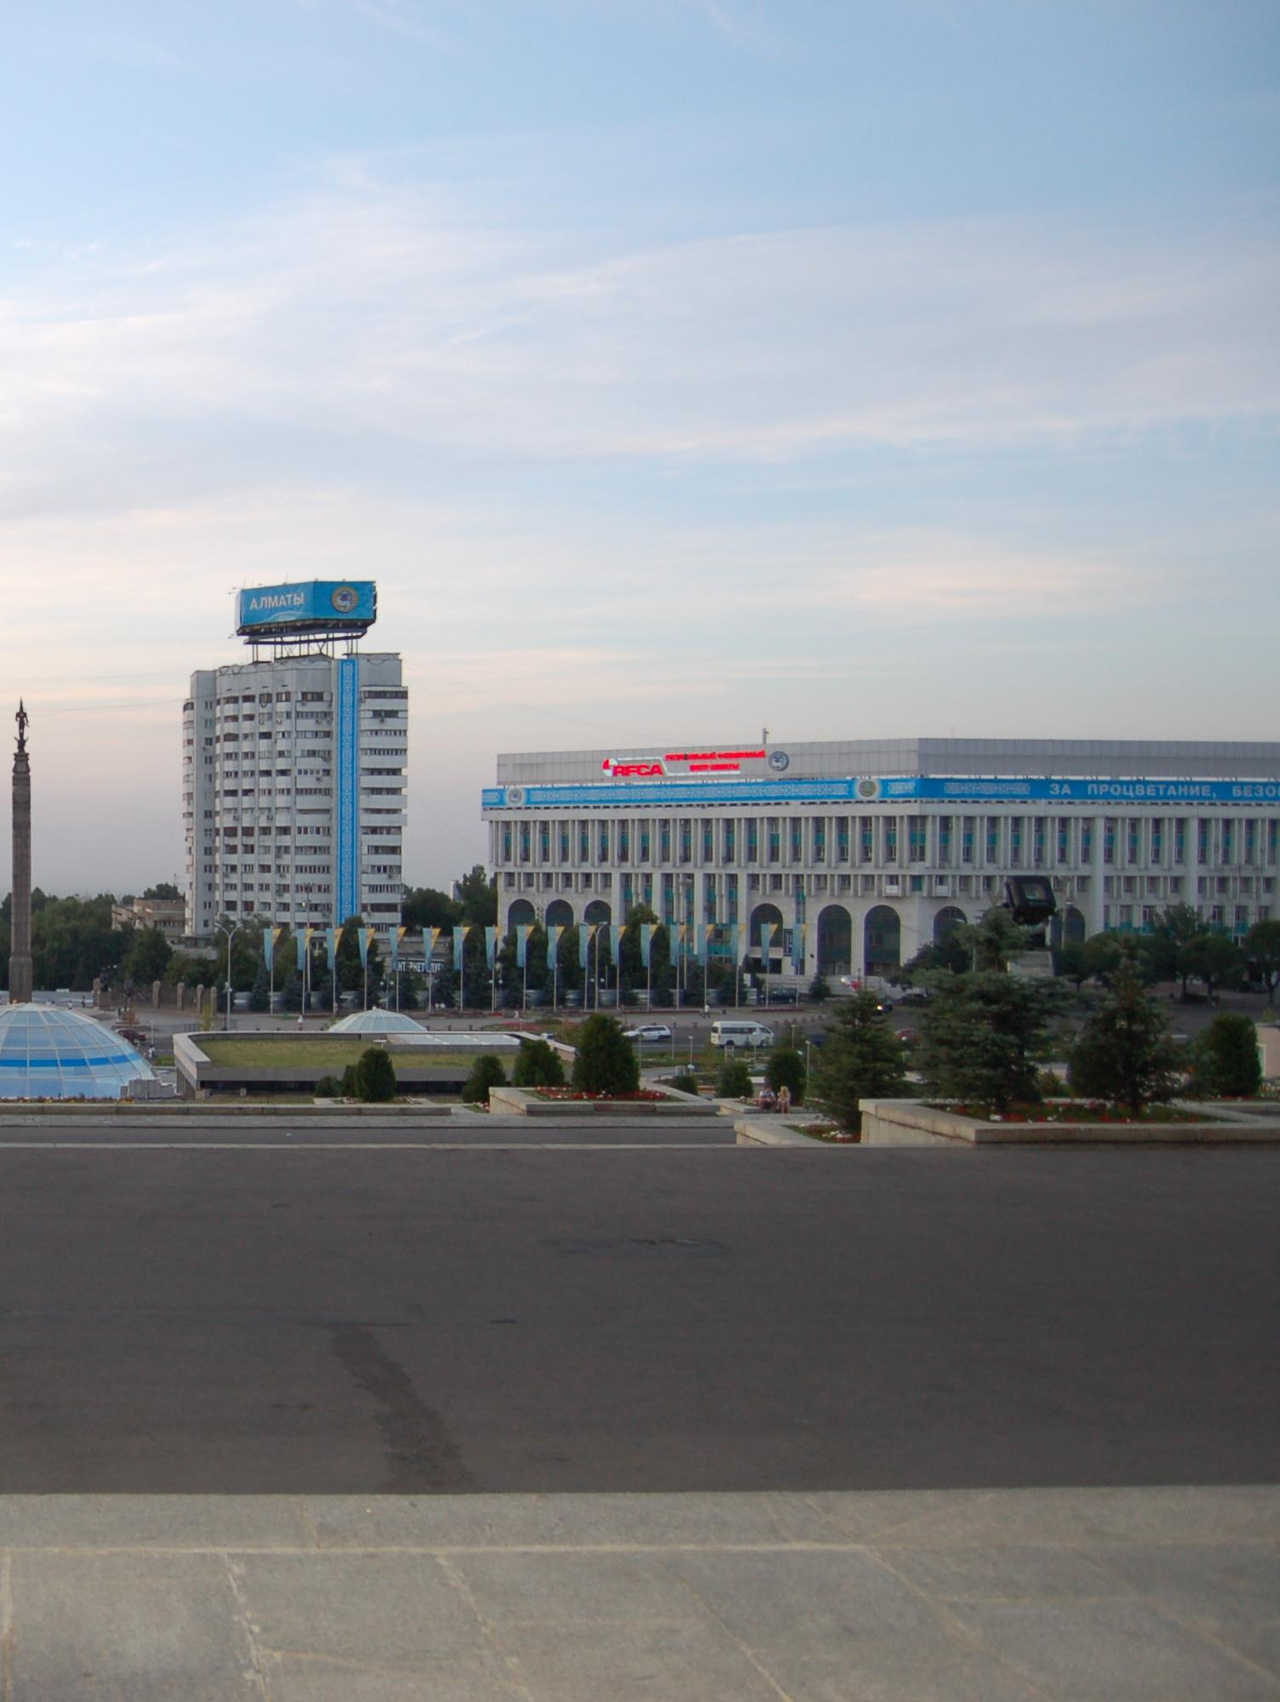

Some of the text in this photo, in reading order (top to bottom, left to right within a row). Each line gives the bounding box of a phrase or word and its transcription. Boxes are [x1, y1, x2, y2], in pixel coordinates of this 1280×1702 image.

[249, 592, 305, 610] АЛМАТЫ
[612, 764, 664, 777] RFCA
[1049, 783, 1280, 799] ЗА ПРОЦВЕТАНИЕ, БЕЗО
